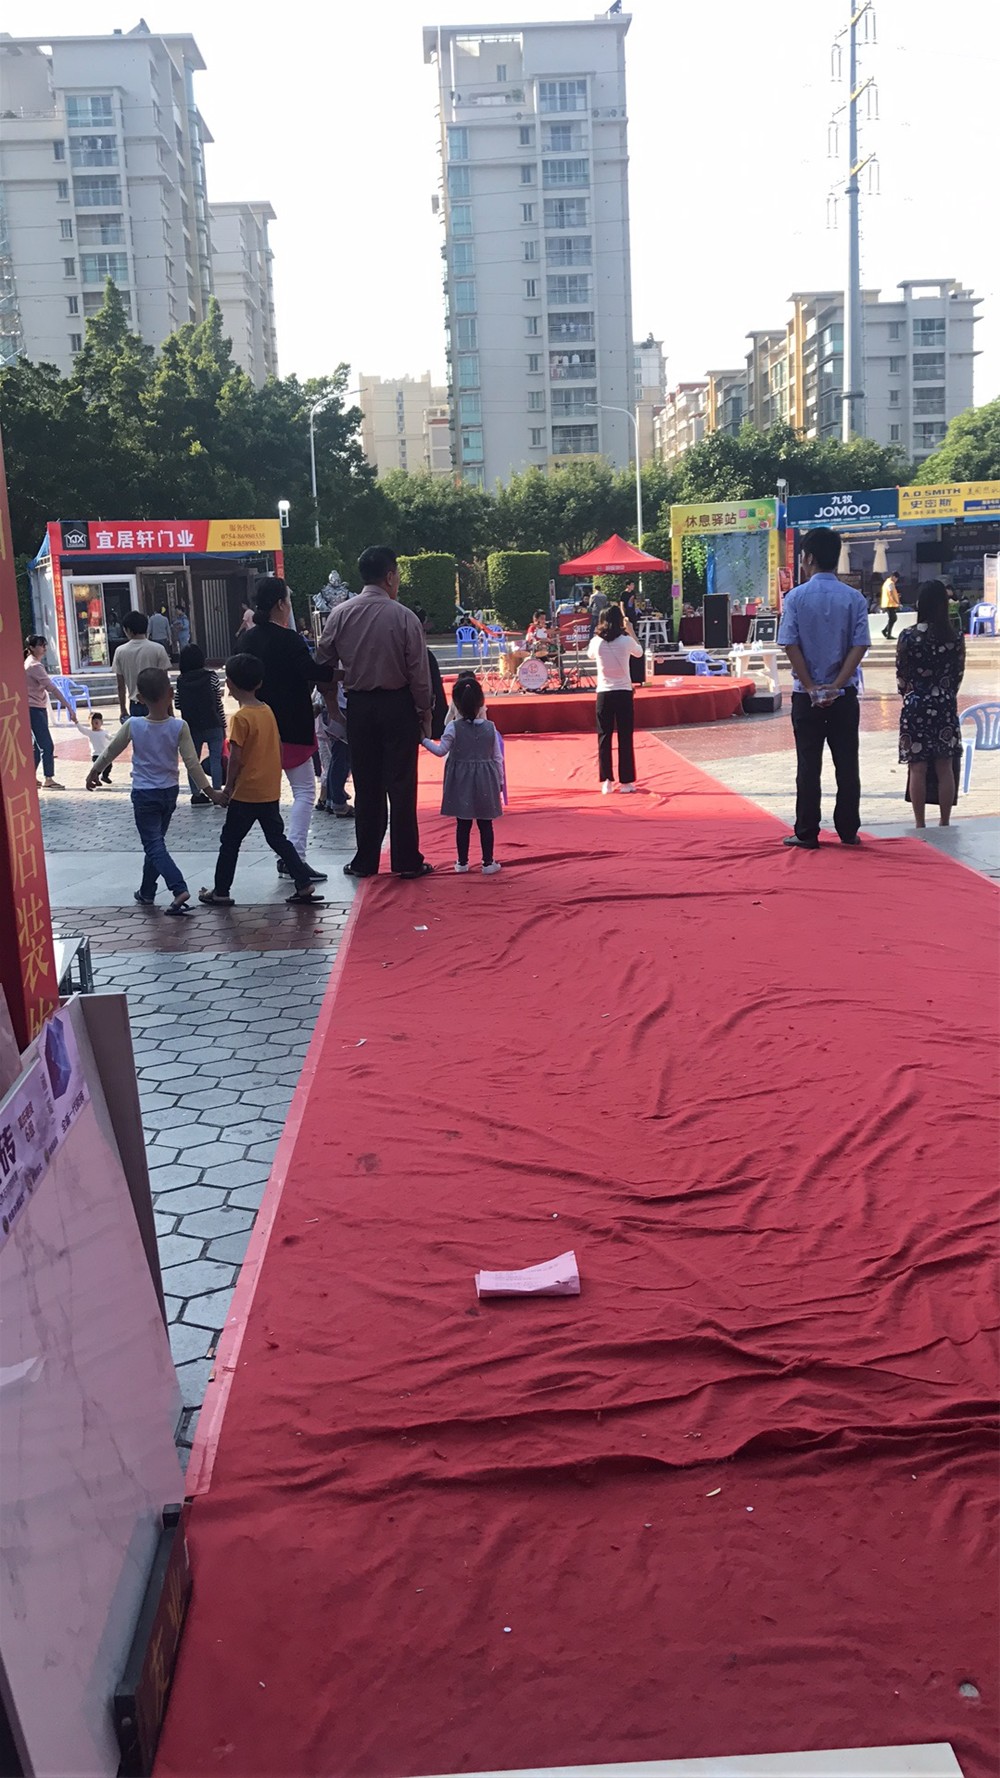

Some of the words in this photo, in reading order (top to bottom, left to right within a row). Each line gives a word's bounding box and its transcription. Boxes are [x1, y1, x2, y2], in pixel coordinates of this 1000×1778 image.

[831, 494, 853, 505] 九牧
[910, 498, 952, 509] 史密斯
[814, 503, 871, 518] JOMOO
[685, 512, 737, 528] 休息驿站
[95, 529, 195, 549] 宜居轩门业
